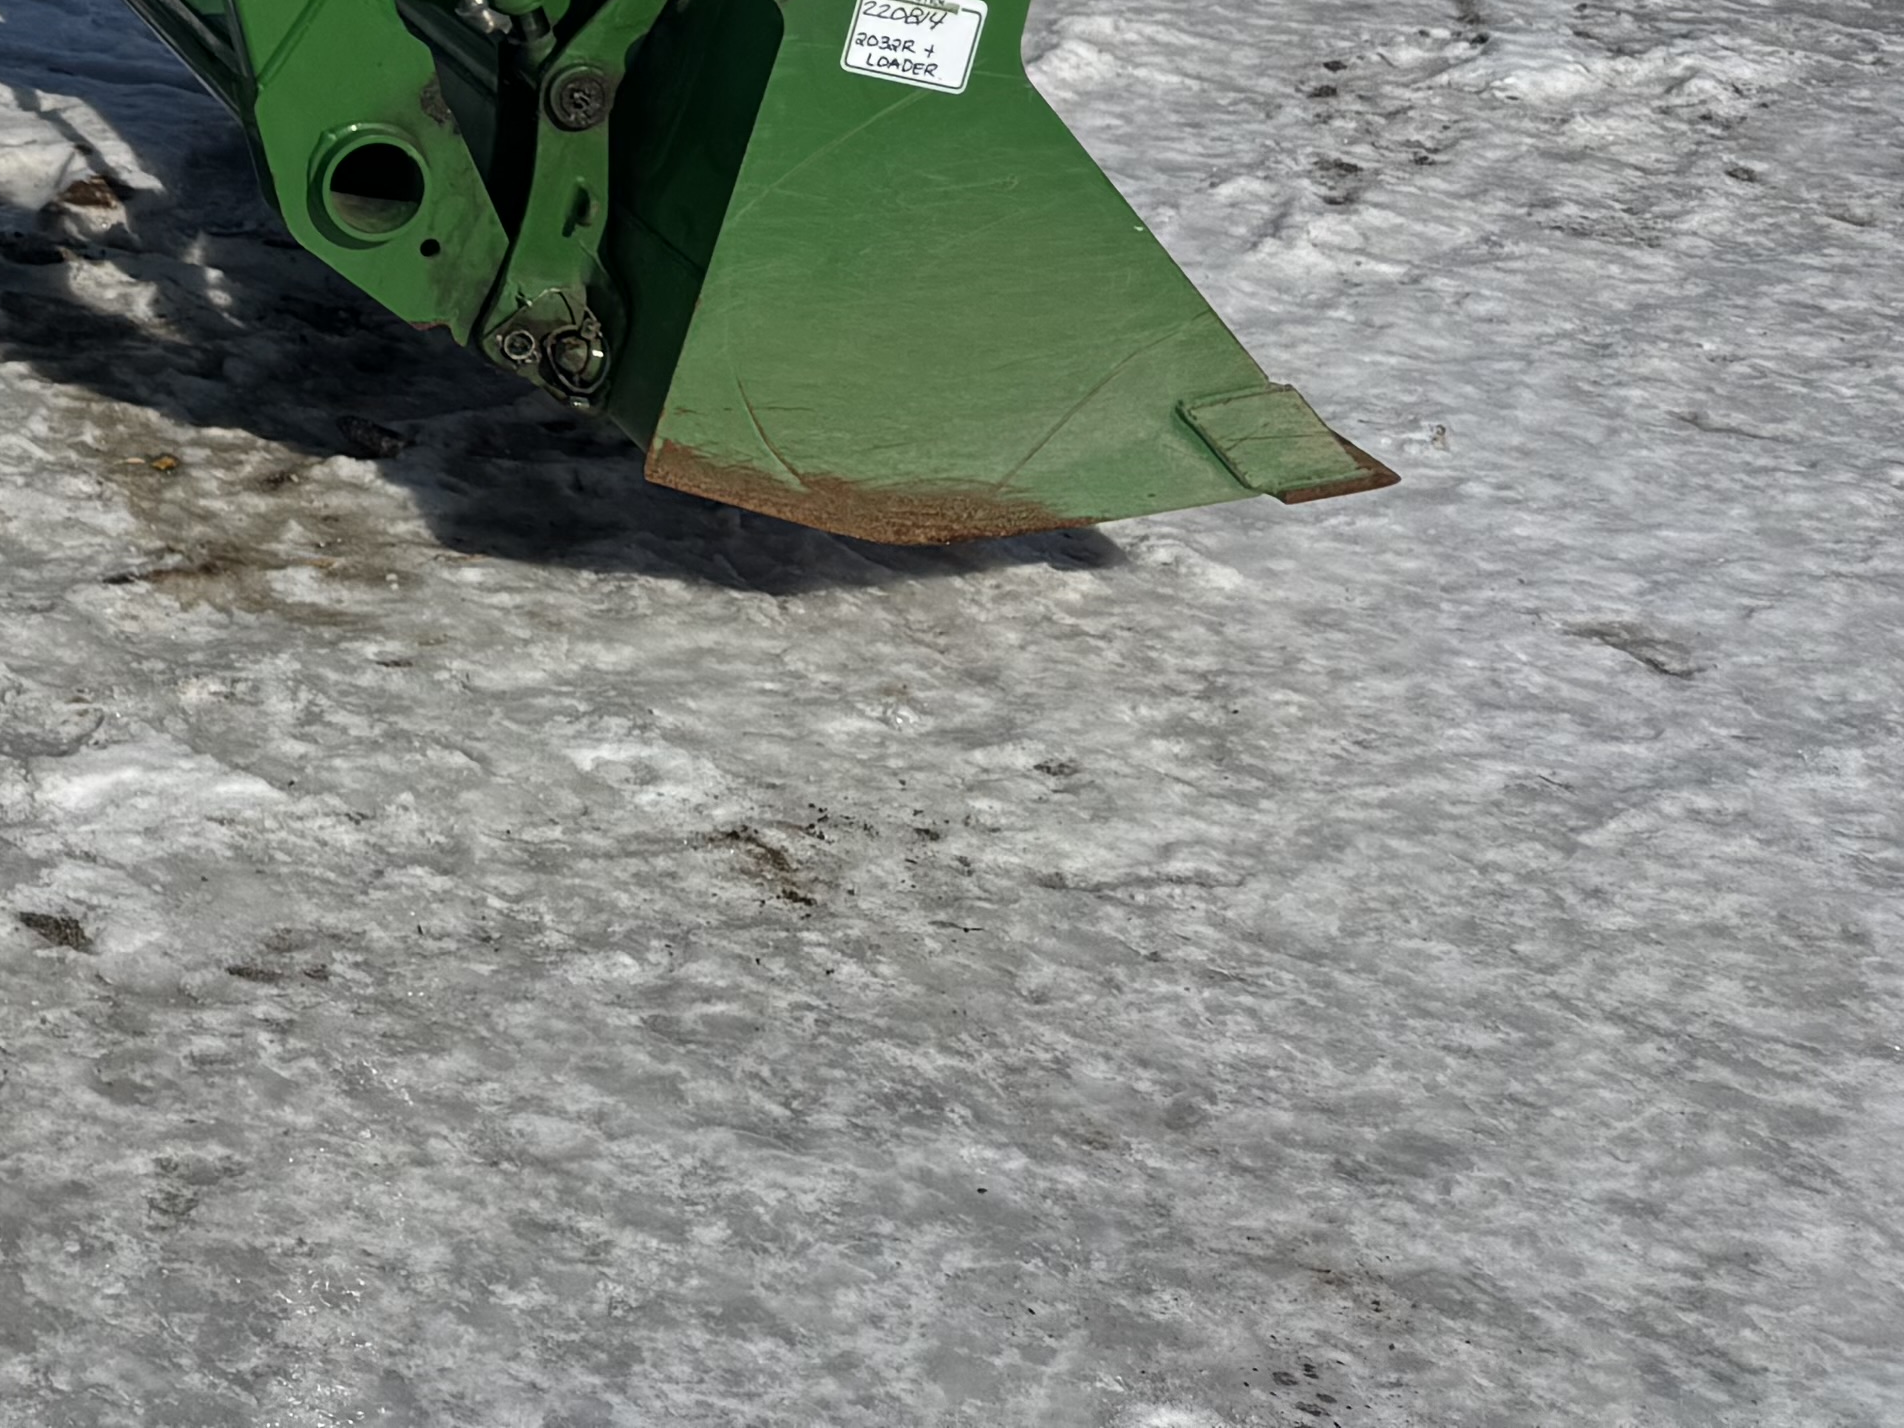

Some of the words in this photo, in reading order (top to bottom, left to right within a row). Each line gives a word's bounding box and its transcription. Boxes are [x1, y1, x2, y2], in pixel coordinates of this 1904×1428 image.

[862, 0, 947, 30] 220814
[855, 32, 916, 54] 2032R
[865, 52, 940, 78] LOADER
